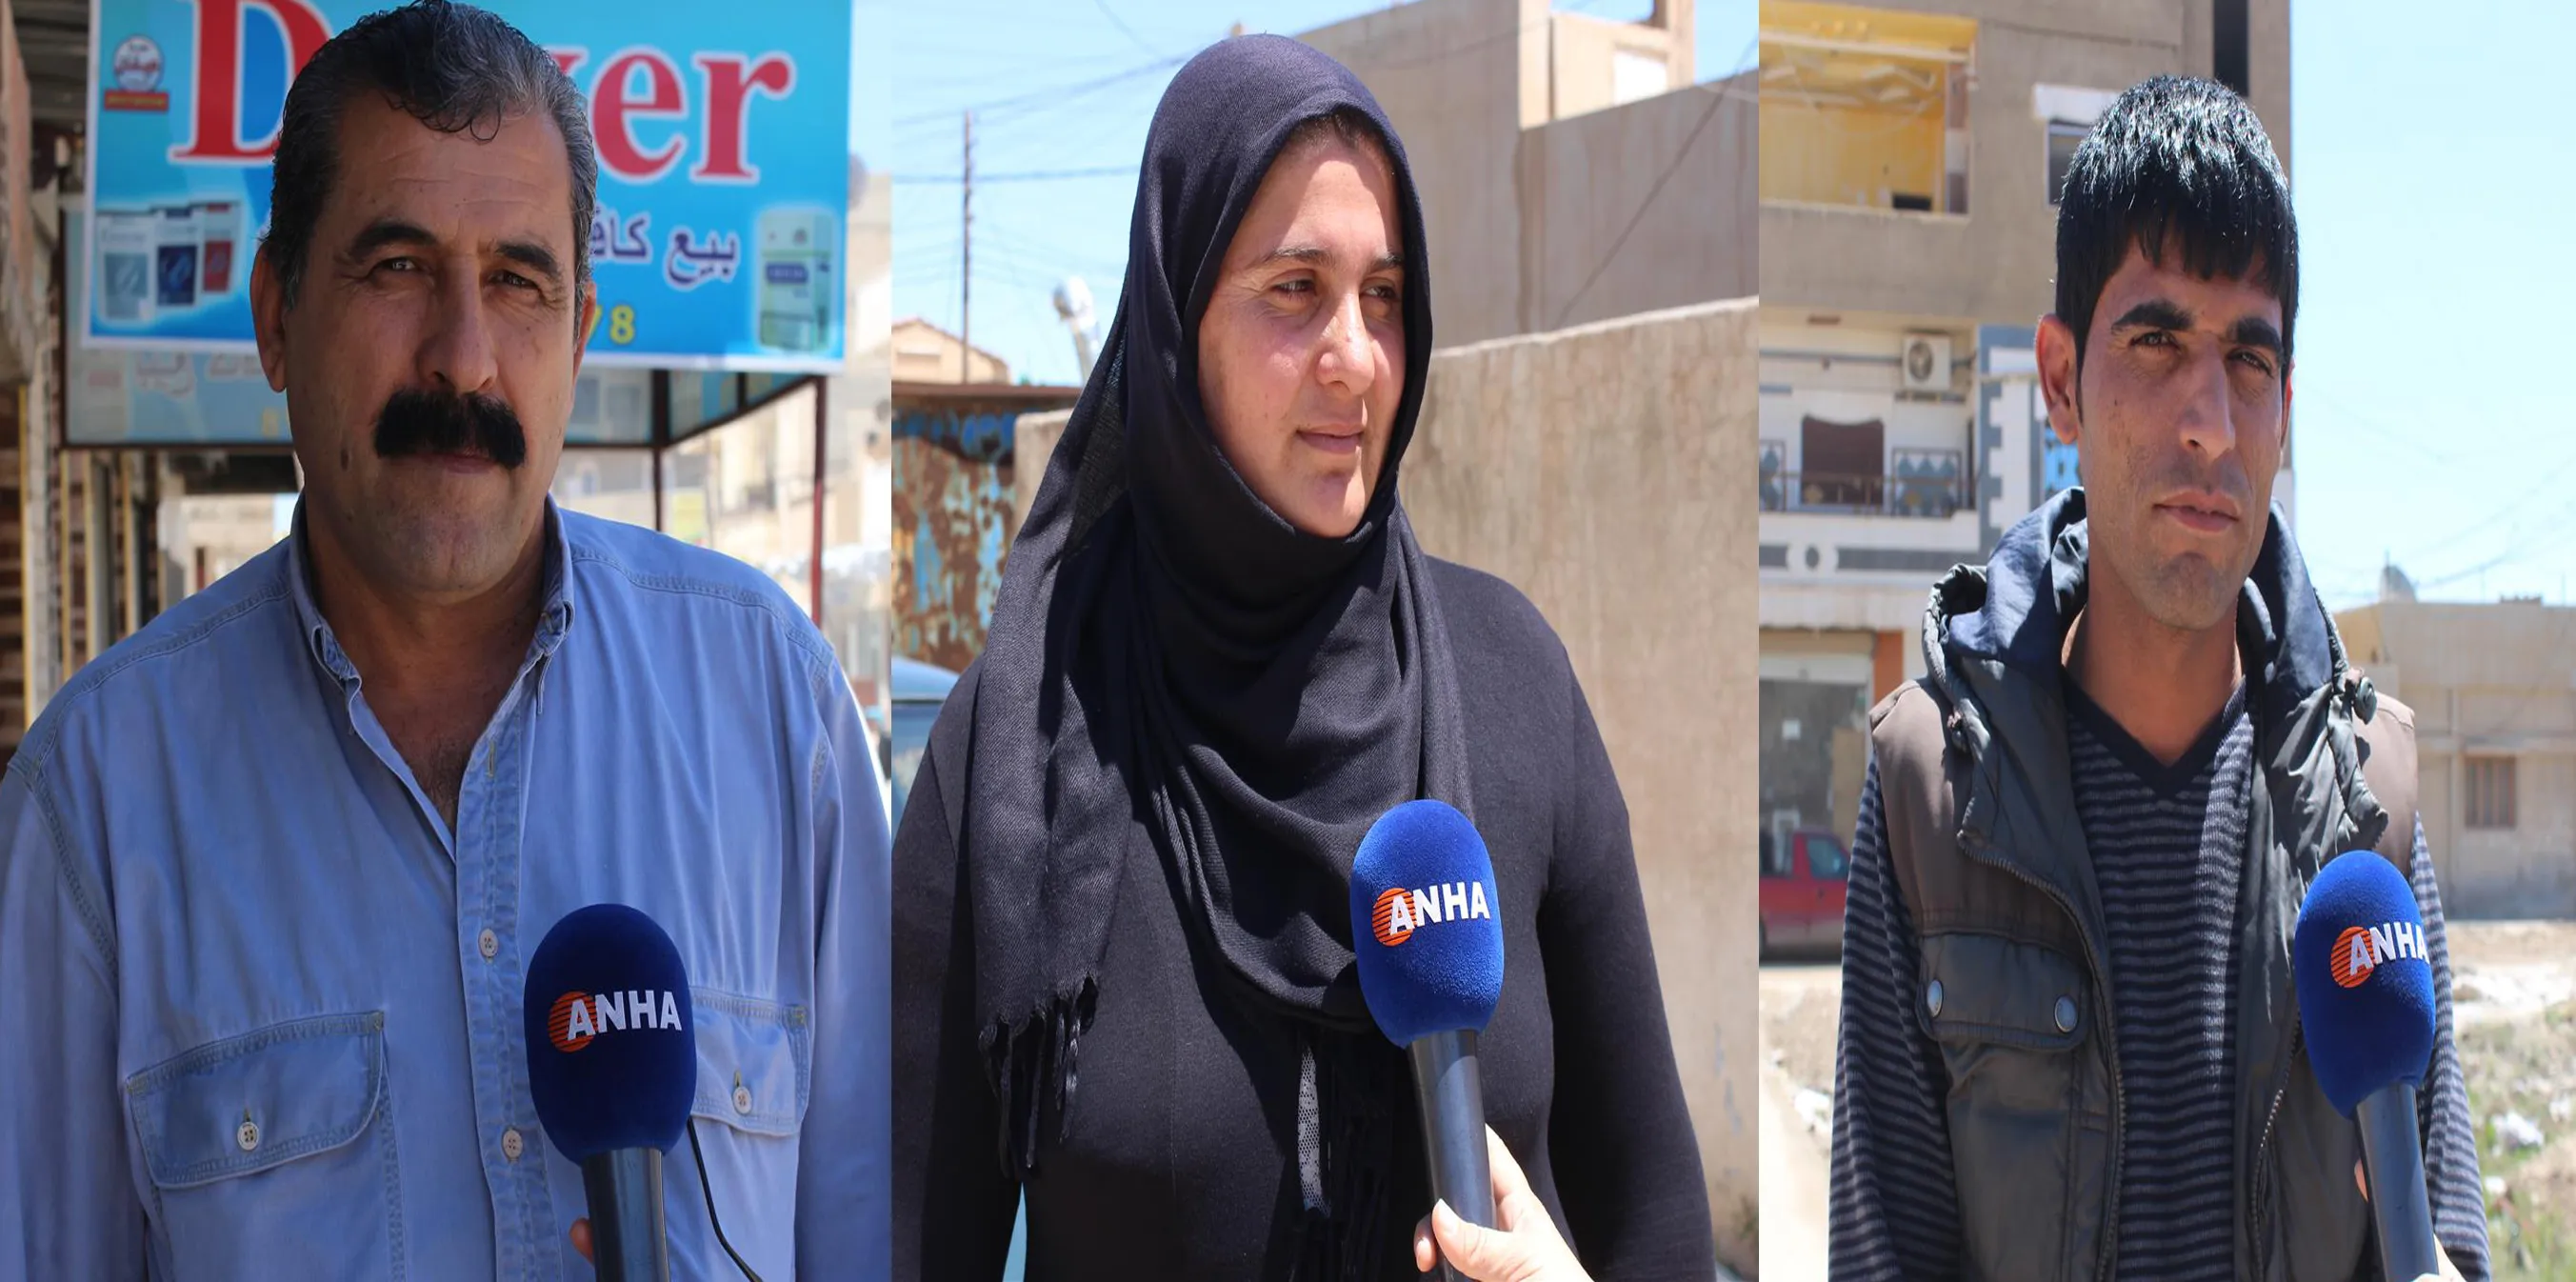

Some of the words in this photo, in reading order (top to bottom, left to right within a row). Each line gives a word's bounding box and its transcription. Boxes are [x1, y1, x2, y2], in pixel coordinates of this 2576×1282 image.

[668, 230, 735, 285] بيع
[1389, 881, 1491, 936] ANHA
[2349, 921, 2430, 976] ANHA
[567, 990, 683, 1041] ANHA
